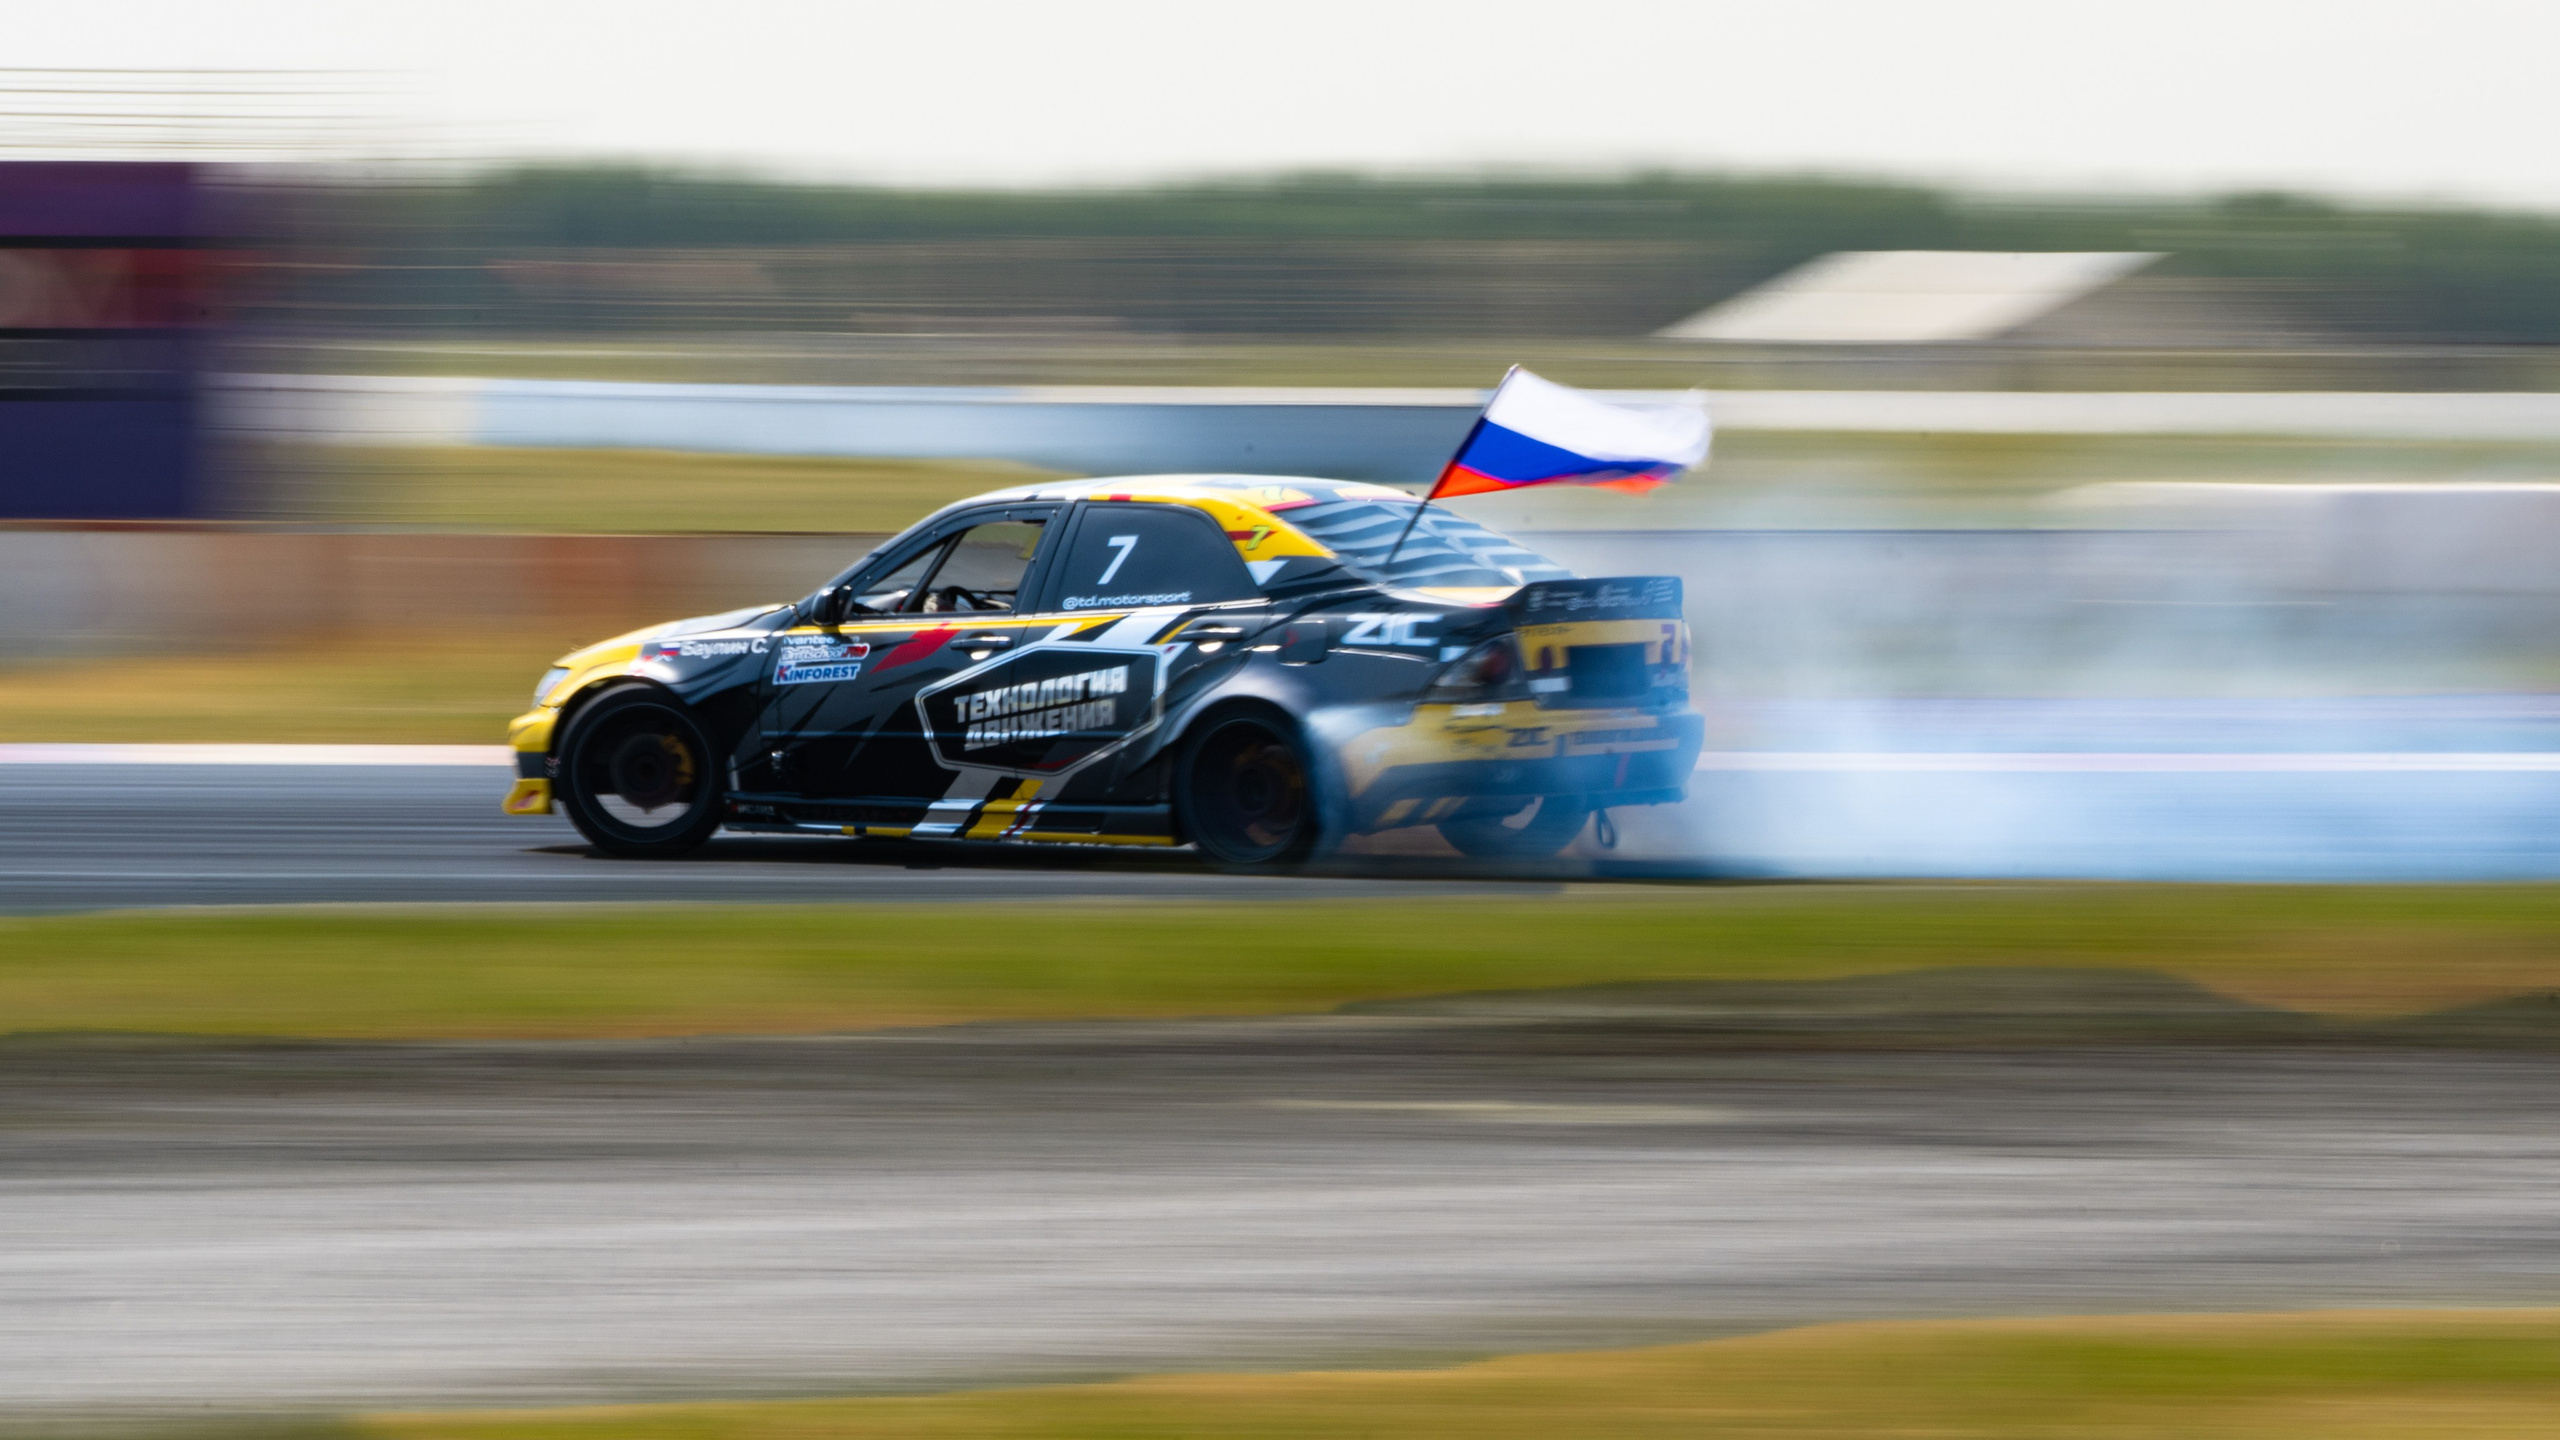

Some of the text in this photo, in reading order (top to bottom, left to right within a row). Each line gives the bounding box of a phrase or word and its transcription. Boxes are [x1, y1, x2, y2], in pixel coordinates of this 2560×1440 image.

[1246, 525, 1271, 551] 7
[1097, 534, 1140, 585] 7
[1062, 591, 1193, 611] @td.motorsport
[1340, 612, 1444, 647] ZIC
[777, 664, 858, 681] KINFOREST
[954, 665, 1129, 723] ТЕХНОЛОГИЯ
[964, 698, 1117, 751] ДВИЖЕНИЯ
